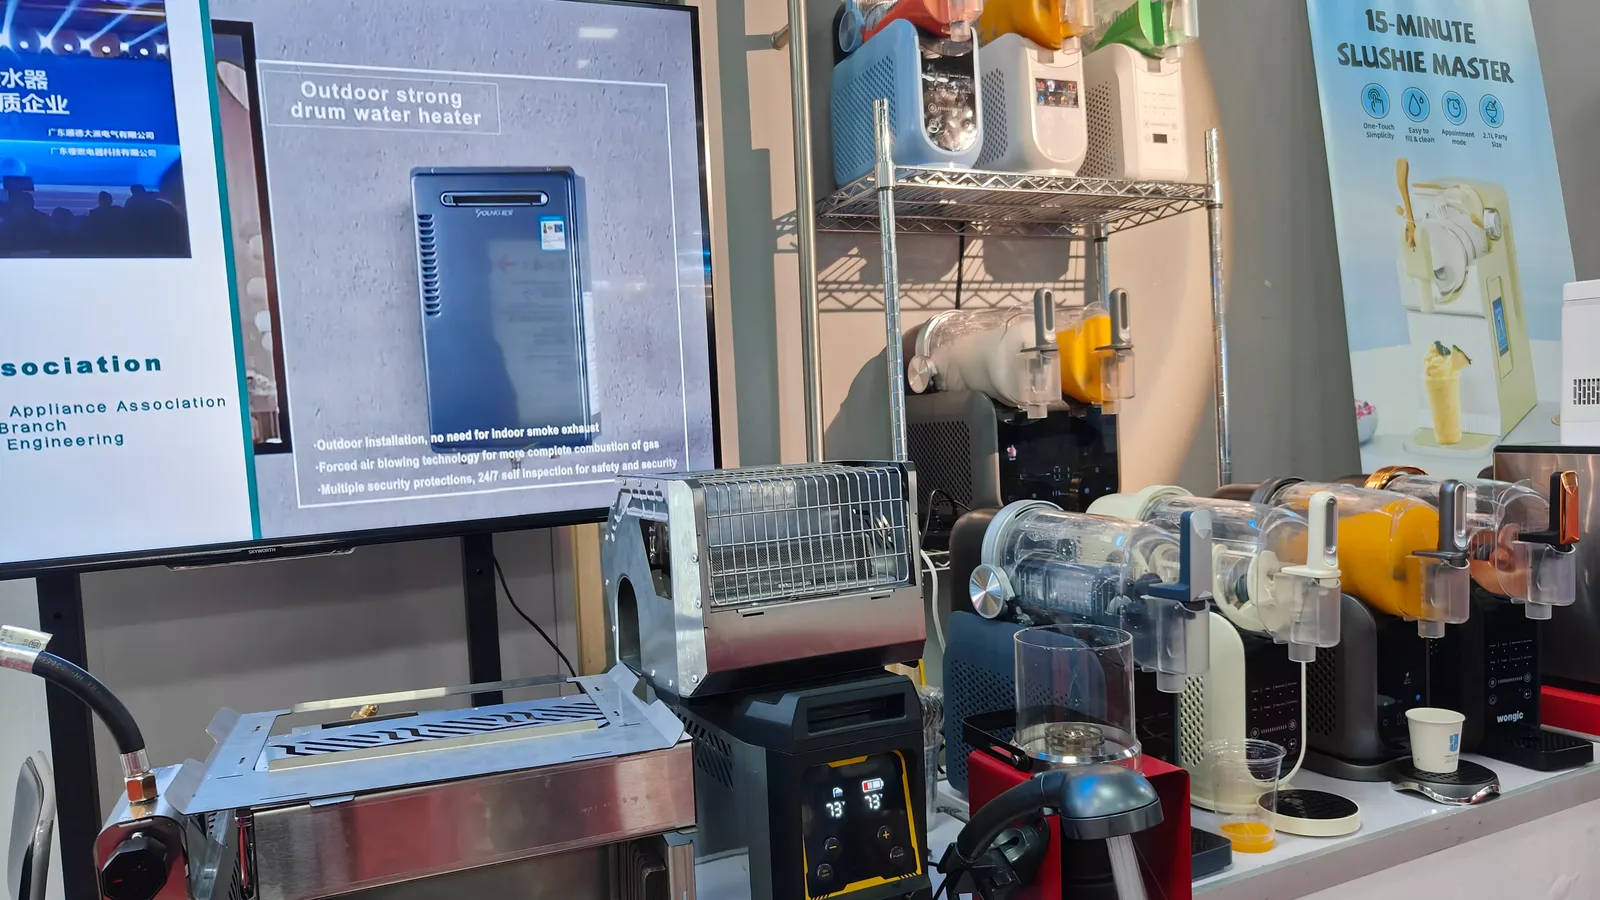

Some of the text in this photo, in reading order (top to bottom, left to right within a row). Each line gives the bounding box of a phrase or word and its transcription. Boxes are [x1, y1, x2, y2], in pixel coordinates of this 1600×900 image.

[1365, 9, 1476, 44] 15-MINUTE
[1337, 42, 1514, 84] SLUSHIE MASTER
[0, 67, 48, 90] 水器
[301, 80, 462, 108] Outdoor strong
[291, 101, 481, 126] drum water heater
[1363, 122, 1395, 130] One-Touch
[1366, 131, 1395, 140] Simplicity
[1408, 127, 1422, 135] Easy
[1441, 129, 1475, 138] Appointment
[1495, 133, 1508, 141] Party
[1, 356, 161, 376] sociation
[9, 396, 226, 419] Appliance Association
[0, 419, 67, 435] Branch
[316, 437, 363, 451] Outdoor
[431, 433, 444, 444] no
[447, 430, 472, 442] need
[474, 429, 489, 440] for
[527, 425, 559, 437] smoke
[561, 422, 600, 435] exhaust
[7, 433, 124, 451] Engineering
[319, 439, 660, 473] Forced air blowing technology for more complete combustion of gas
[321, 457, 678, 496] Multiple security protections, 24/7 self inspection for safety and security
